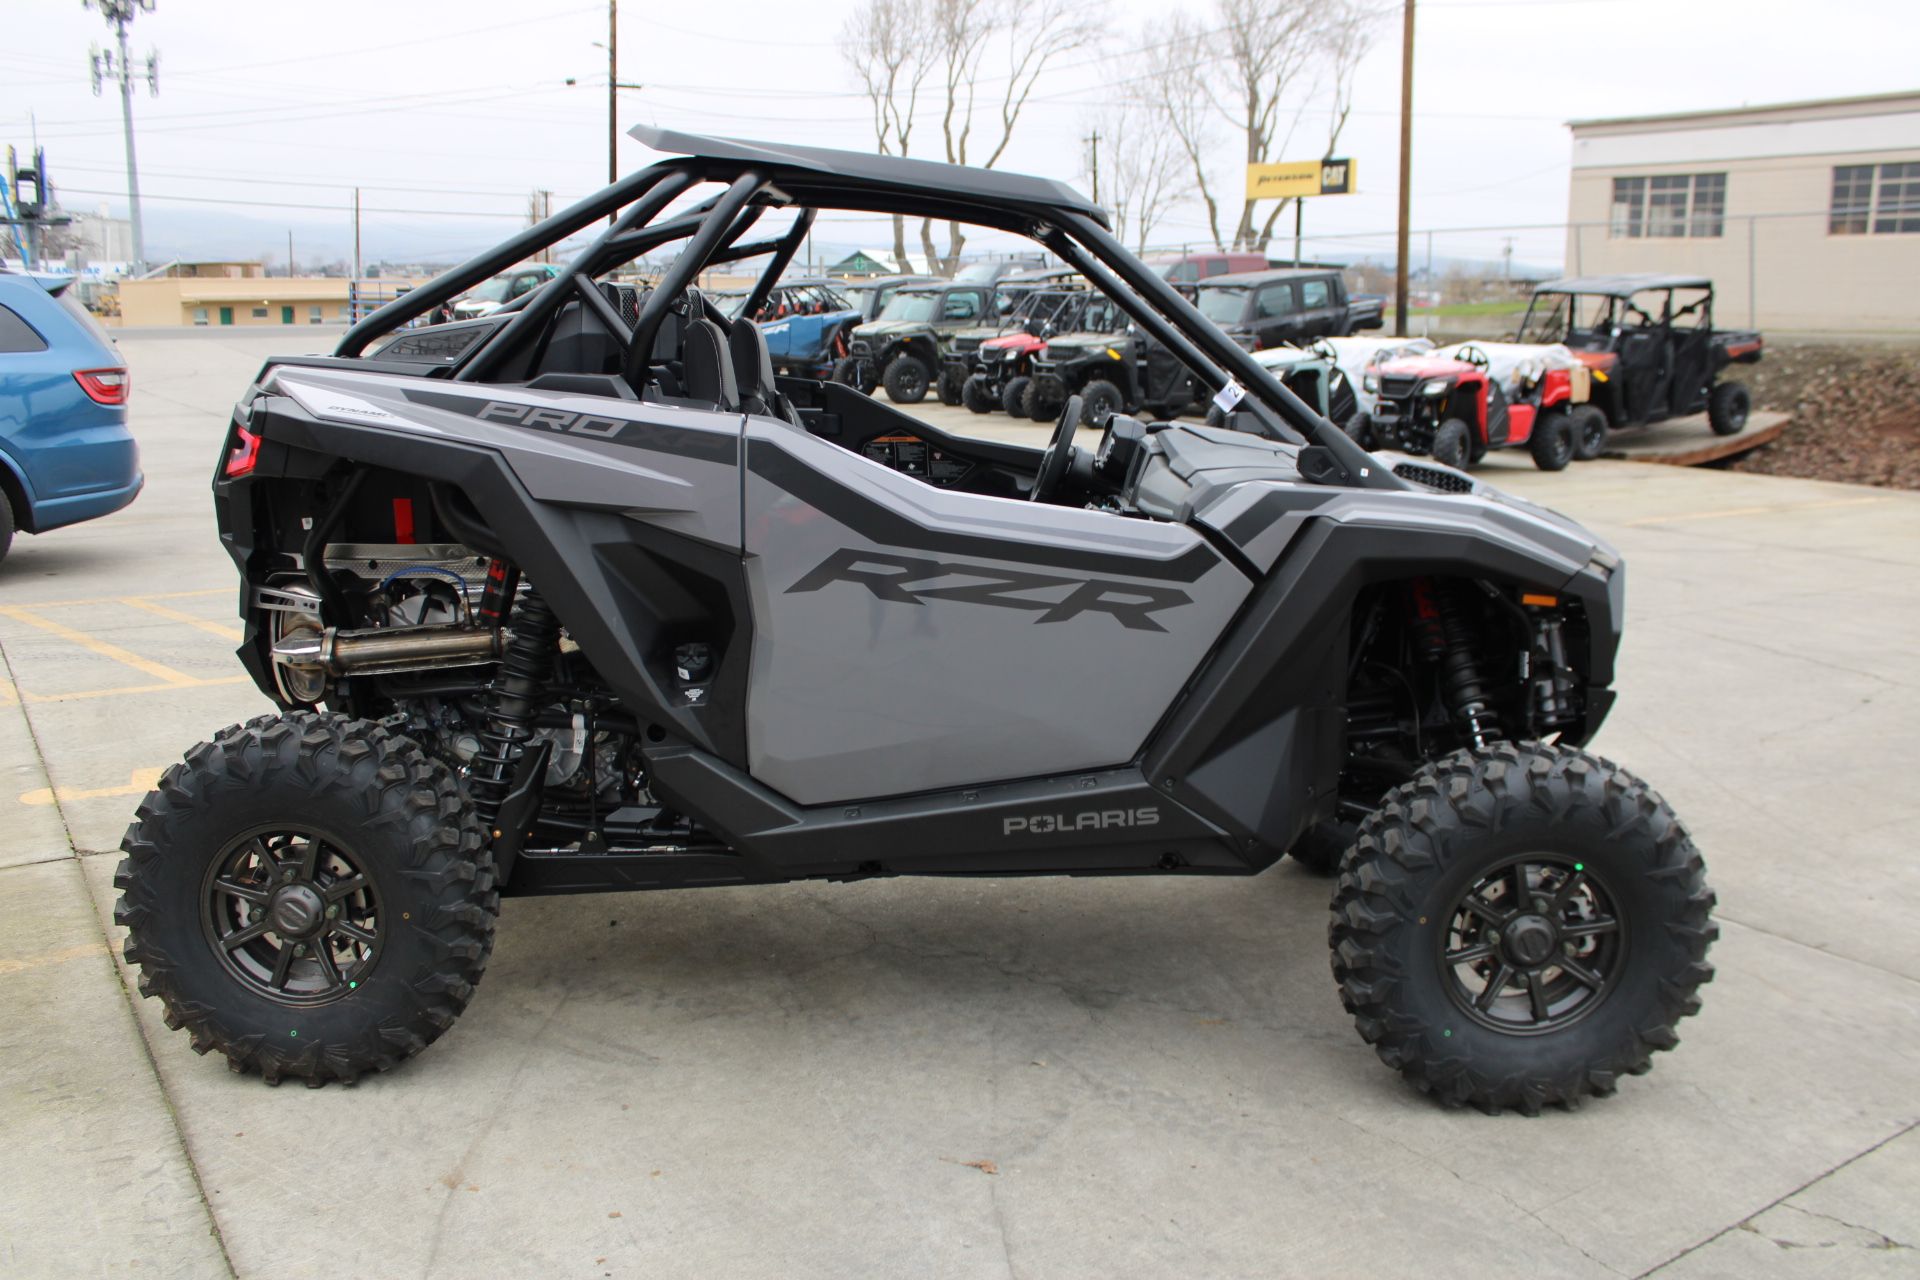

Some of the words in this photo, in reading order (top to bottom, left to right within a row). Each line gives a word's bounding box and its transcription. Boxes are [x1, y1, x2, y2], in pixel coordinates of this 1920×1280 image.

[1321, 165, 1346, 187] CAT
[476, 401, 629, 438] PRO
[783, 548, 1194, 633] RZR
[1003, 807, 1159, 835] POLARIS
